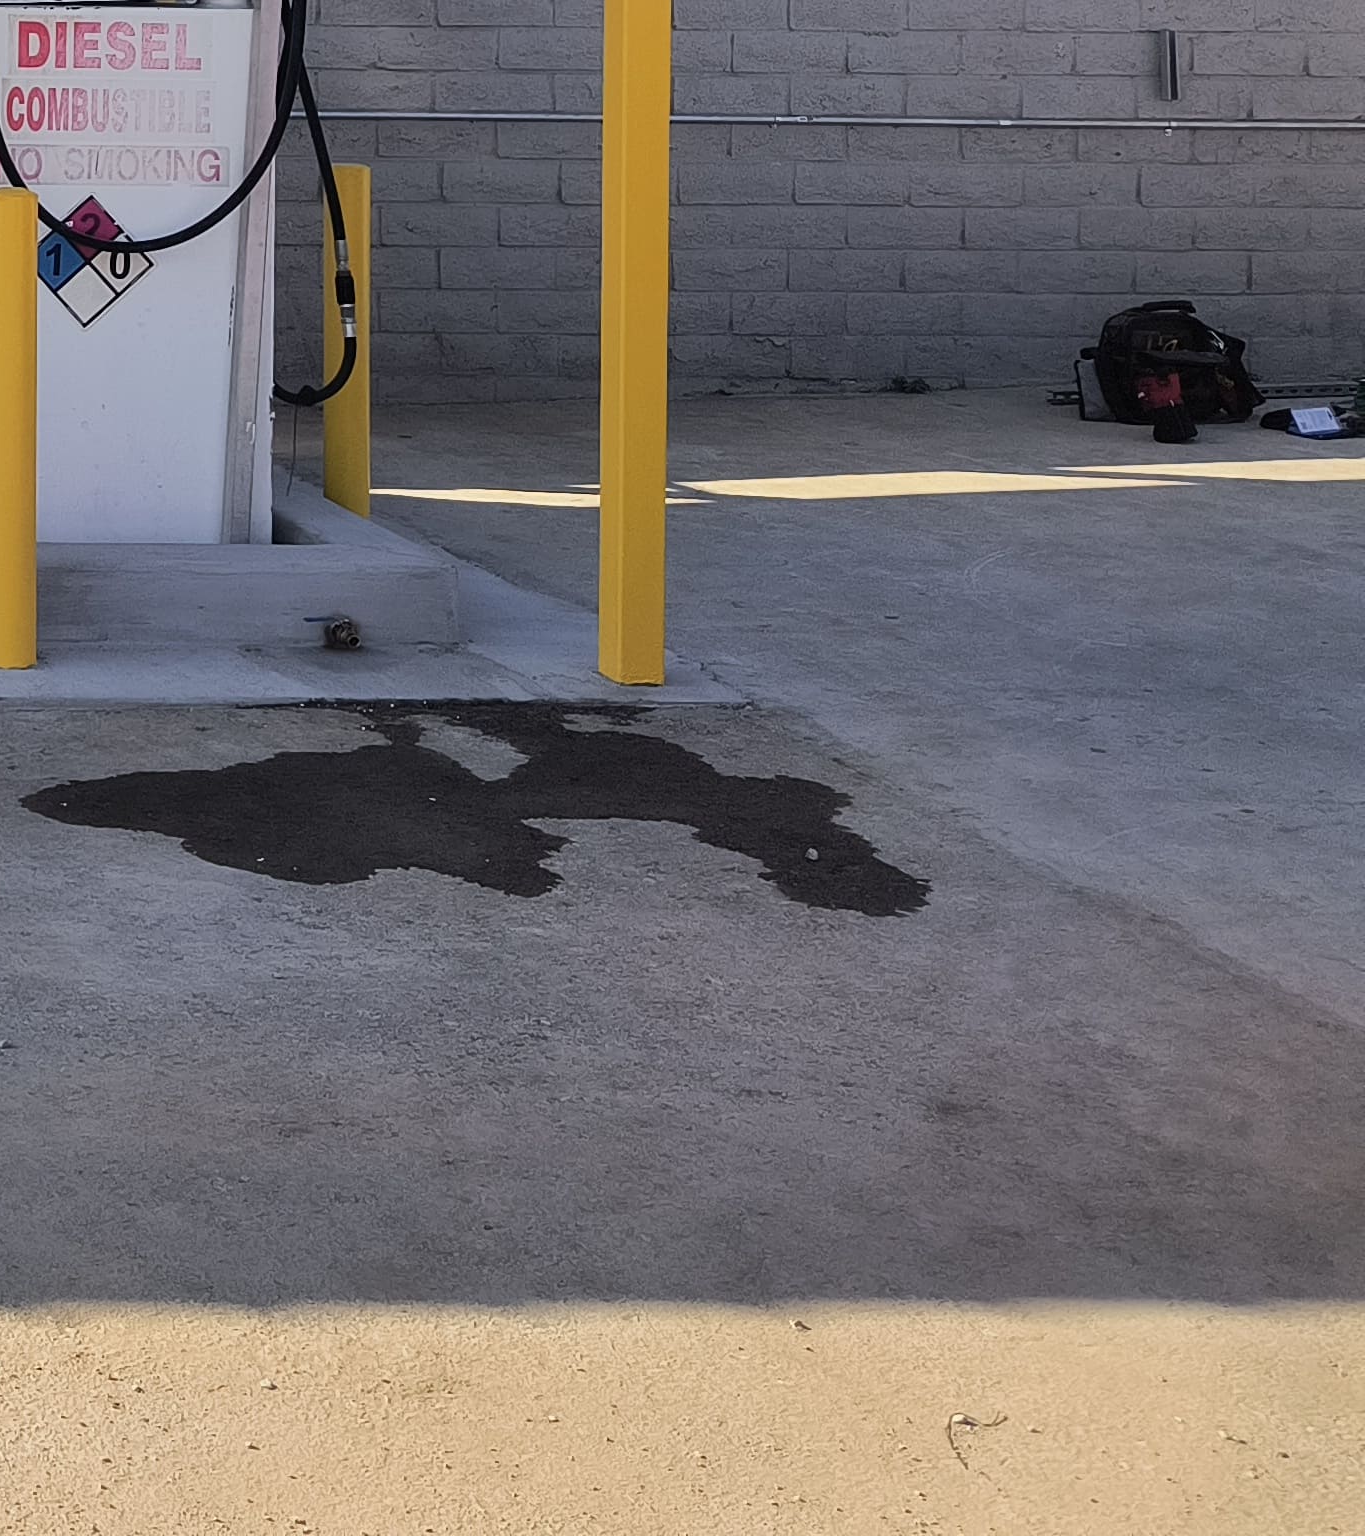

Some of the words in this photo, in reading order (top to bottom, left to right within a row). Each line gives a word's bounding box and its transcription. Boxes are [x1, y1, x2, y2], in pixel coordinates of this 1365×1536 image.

[18, 21, 201, 70] DIESEL
[6, 86, 211, 133] COMBUSTIBLE
[64, 147, 221, 183] SMOKING
[80, 213, 101, 236] 2
[46, 243, 62, 276] 1
[110, 251, 130, 280] 0
